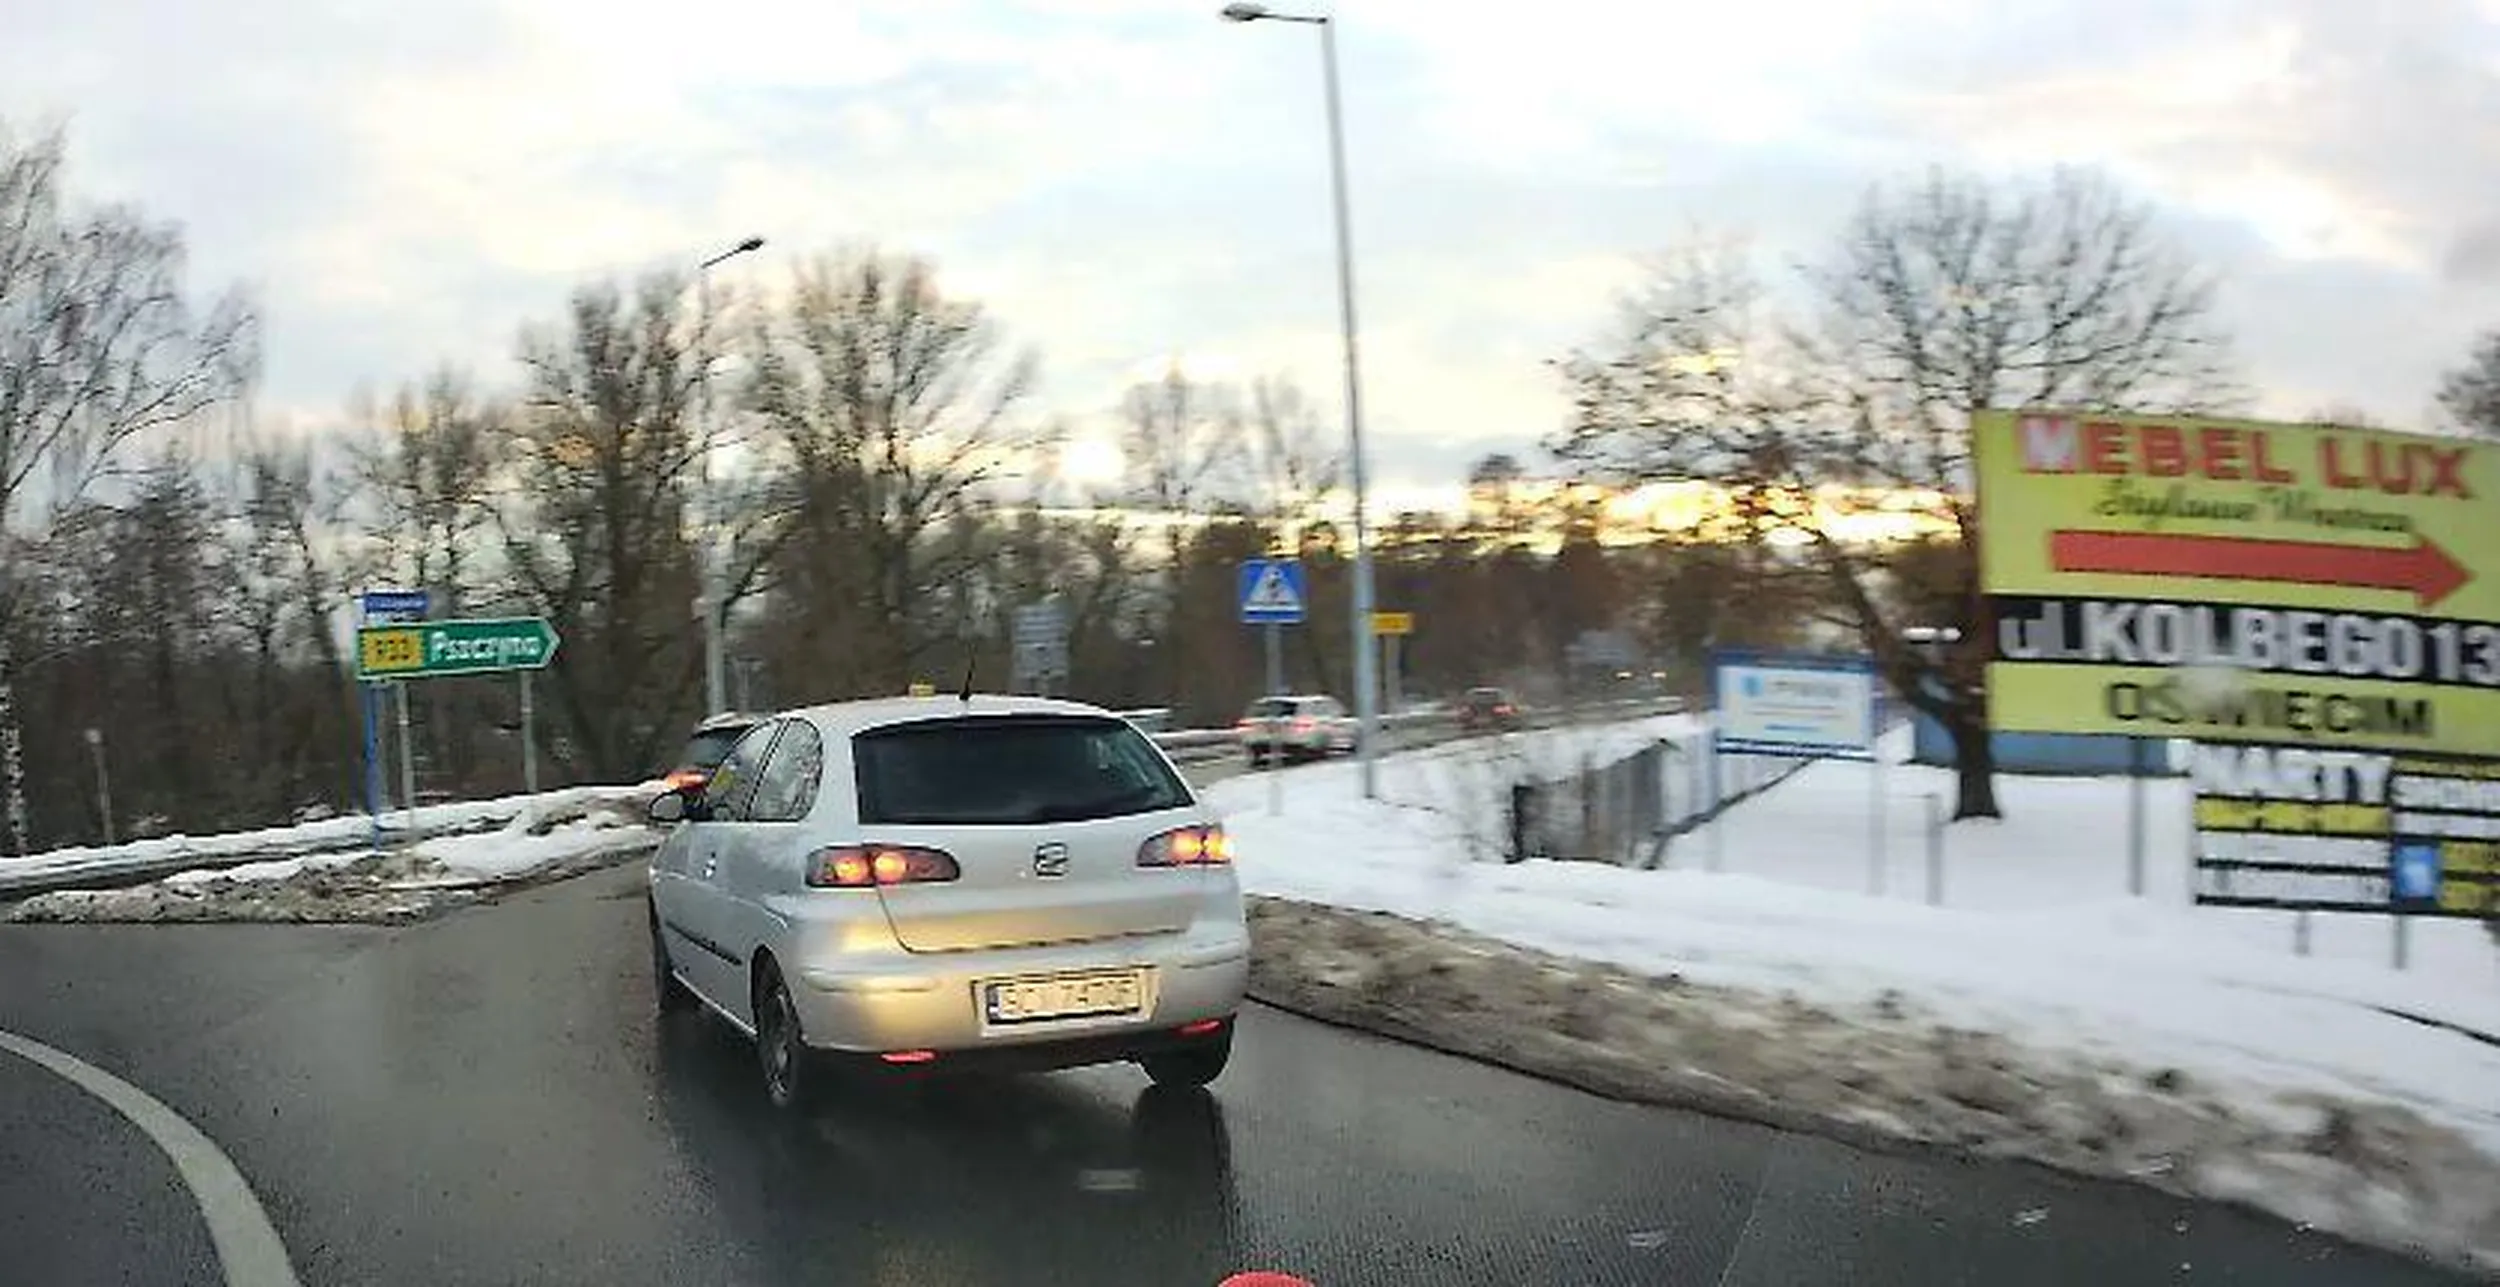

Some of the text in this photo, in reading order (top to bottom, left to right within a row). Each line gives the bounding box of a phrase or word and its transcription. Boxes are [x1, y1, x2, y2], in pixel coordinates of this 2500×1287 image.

[2017, 414, 2475, 500] MEBEL LUX
[430, 631, 540, 665] Pszczyna
[2082, 601, 2424, 679] KOLBEGO
